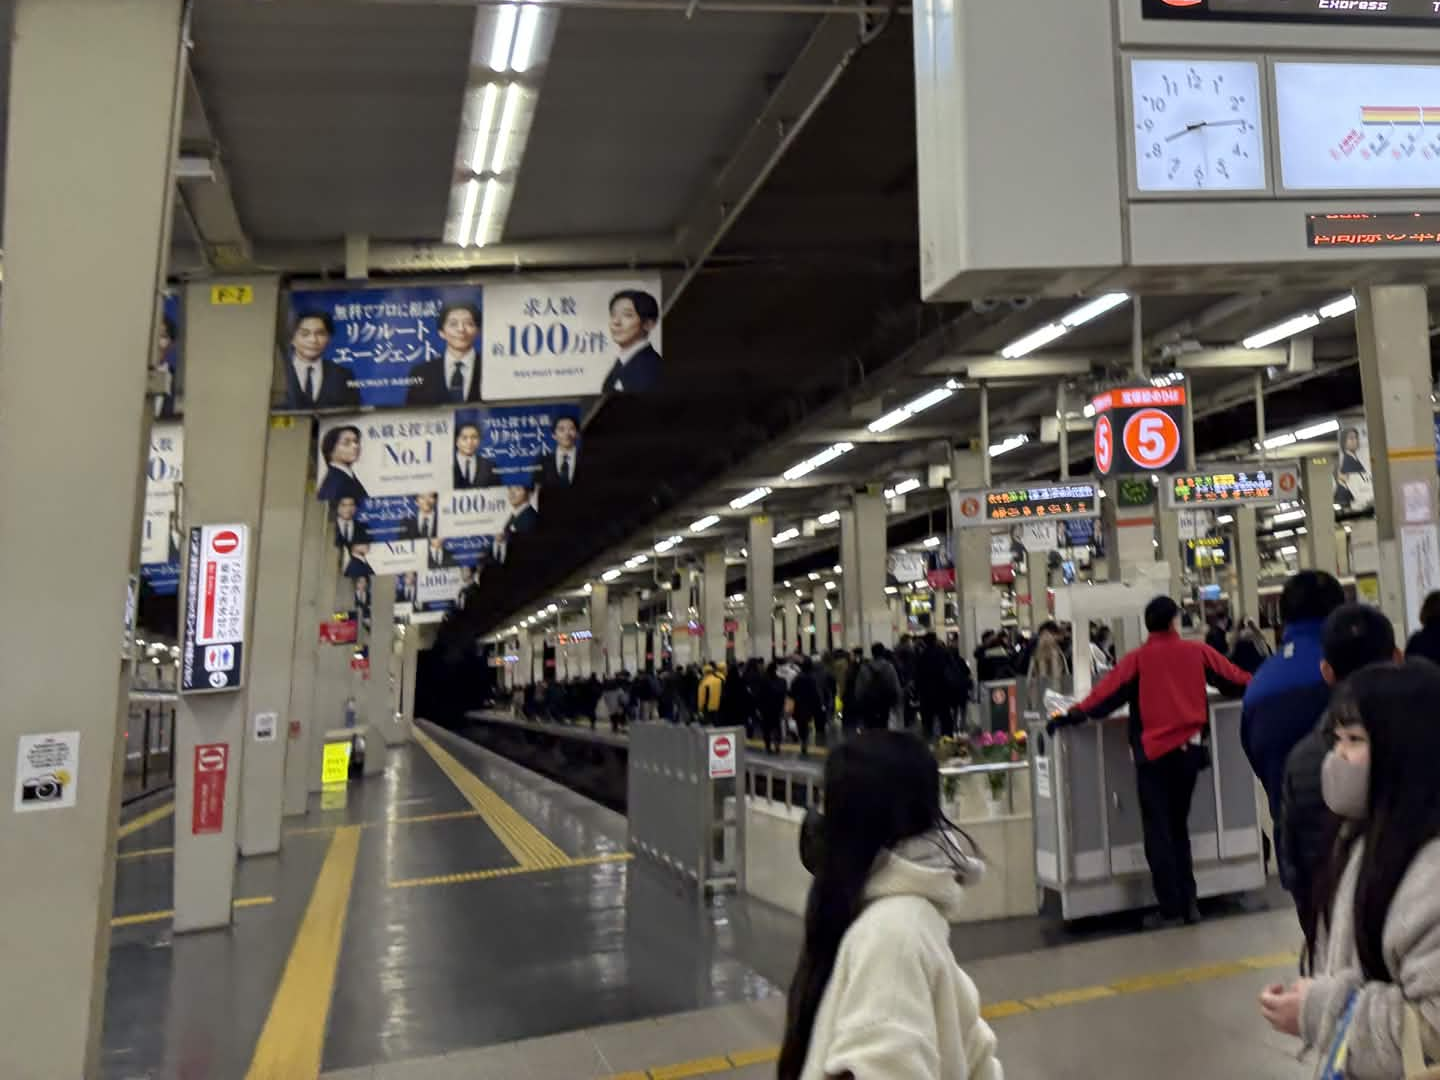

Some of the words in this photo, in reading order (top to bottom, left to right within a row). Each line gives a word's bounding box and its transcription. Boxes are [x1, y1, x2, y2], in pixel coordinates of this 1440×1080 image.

[347, 320, 430, 343] リクルート
[333, 340, 442, 363] エージェント
[1099, 423, 1109, 465] 5
[1138, 418, 1166, 460] 5
[384, 441, 432, 465] No.1
